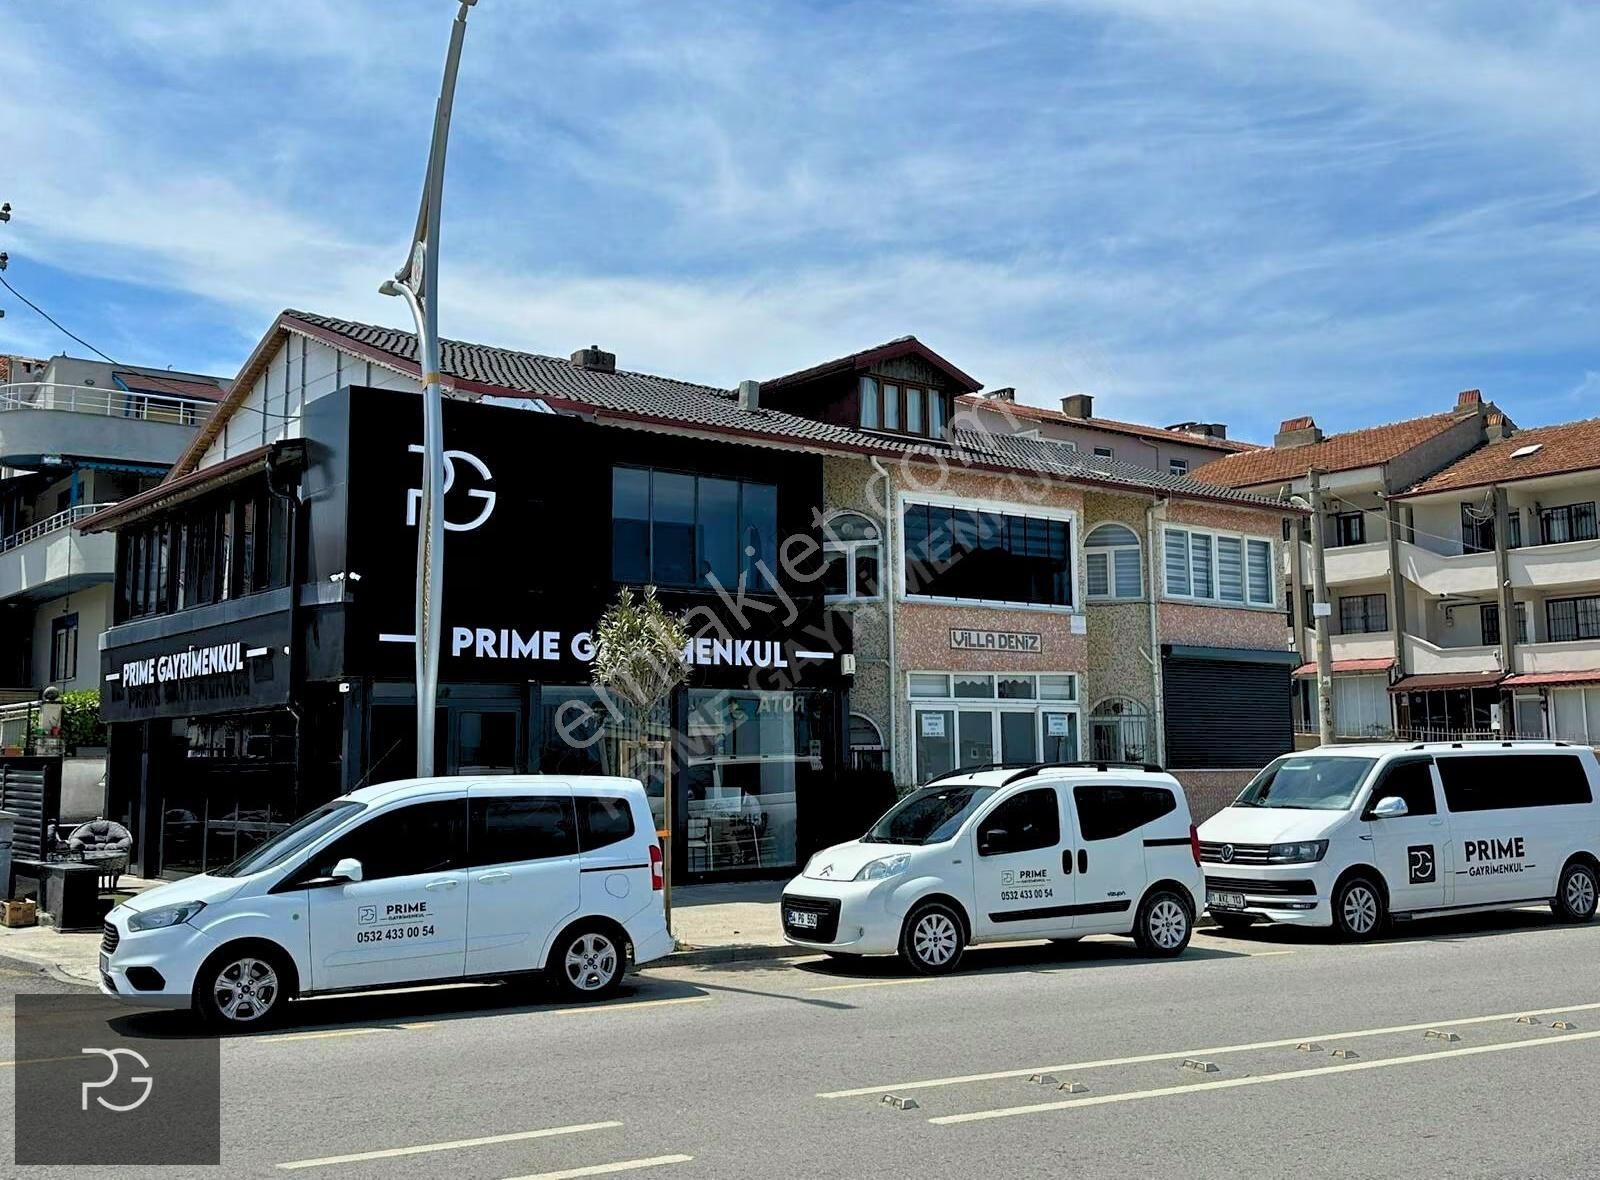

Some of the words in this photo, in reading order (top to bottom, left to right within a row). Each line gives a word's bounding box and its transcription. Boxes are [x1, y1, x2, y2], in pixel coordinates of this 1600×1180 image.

[452, 627, 560, 660] PRIME
[122, 658, 156, 688] PRIME
[157, 642, 244, 682] GAYRİMENKUL
[1464, 837, 1525, 862] PRIME
[1410, 851, 1433, 878] PG
[1469, 862, 1524, 877] GAYRİMENKUL
[1020, 870, 1047, 878] PRIME
[1001, 890, 1018, 900] 0532
[1020, 889, 1033, 899] 433
[1034, 888, 1043, 898] 00
[1044, 888, 1053, 897] 54
[386, 902, 426, 915] PRIME
[357, 930, 382, 943] 0532
[385, 928, 404, 940] 433
[407, 926, 420, 938] 00
[422, 925, 434, 937] 54
